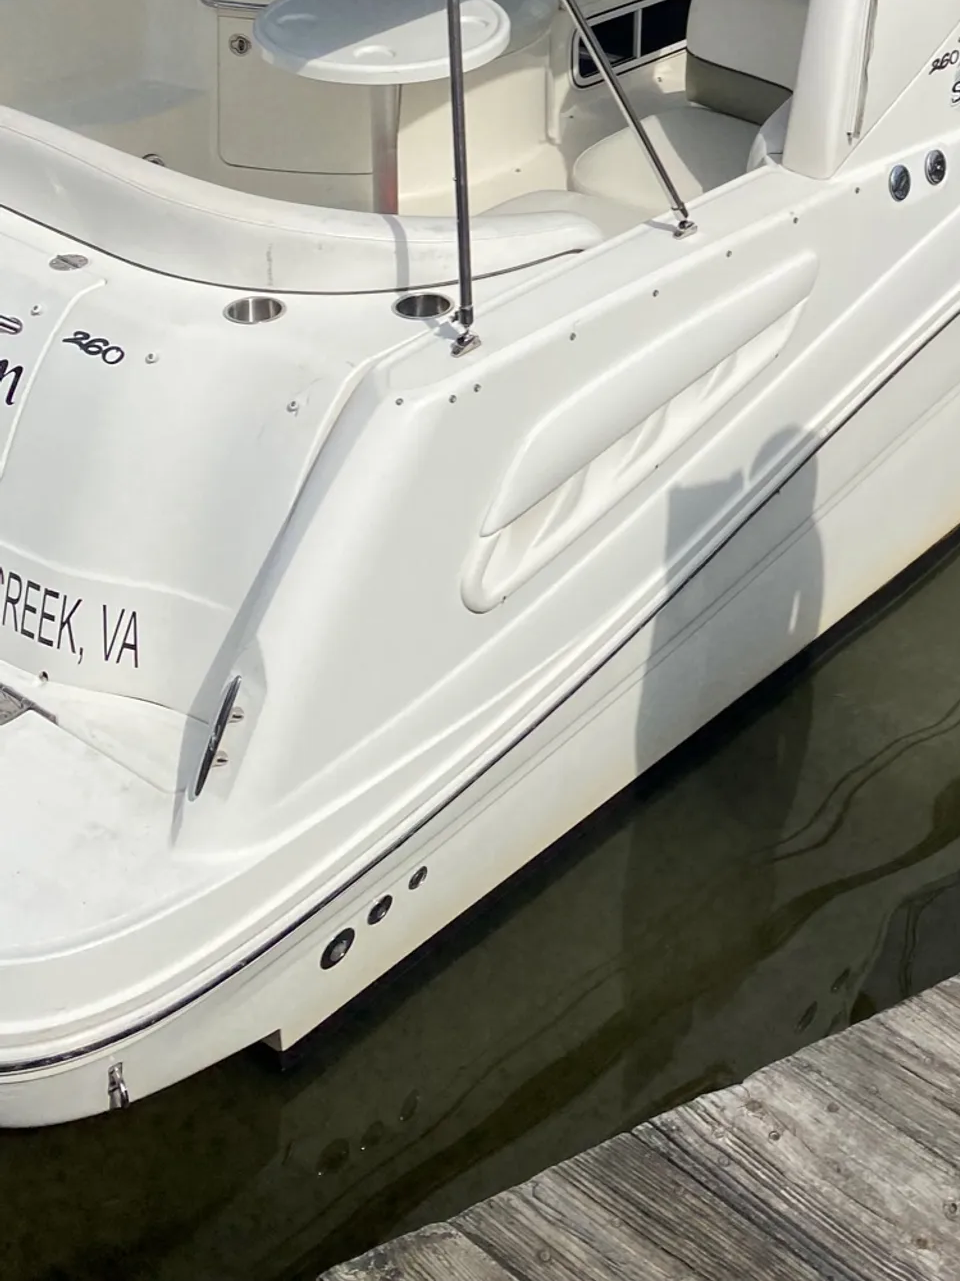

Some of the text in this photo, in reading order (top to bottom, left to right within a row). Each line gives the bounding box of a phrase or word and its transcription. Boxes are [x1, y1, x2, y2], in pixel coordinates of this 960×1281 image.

[929, 50, 960, 75] 260
[62, 330, 125, 365] 260
[0, 566, 138, 669] REEK, VA
